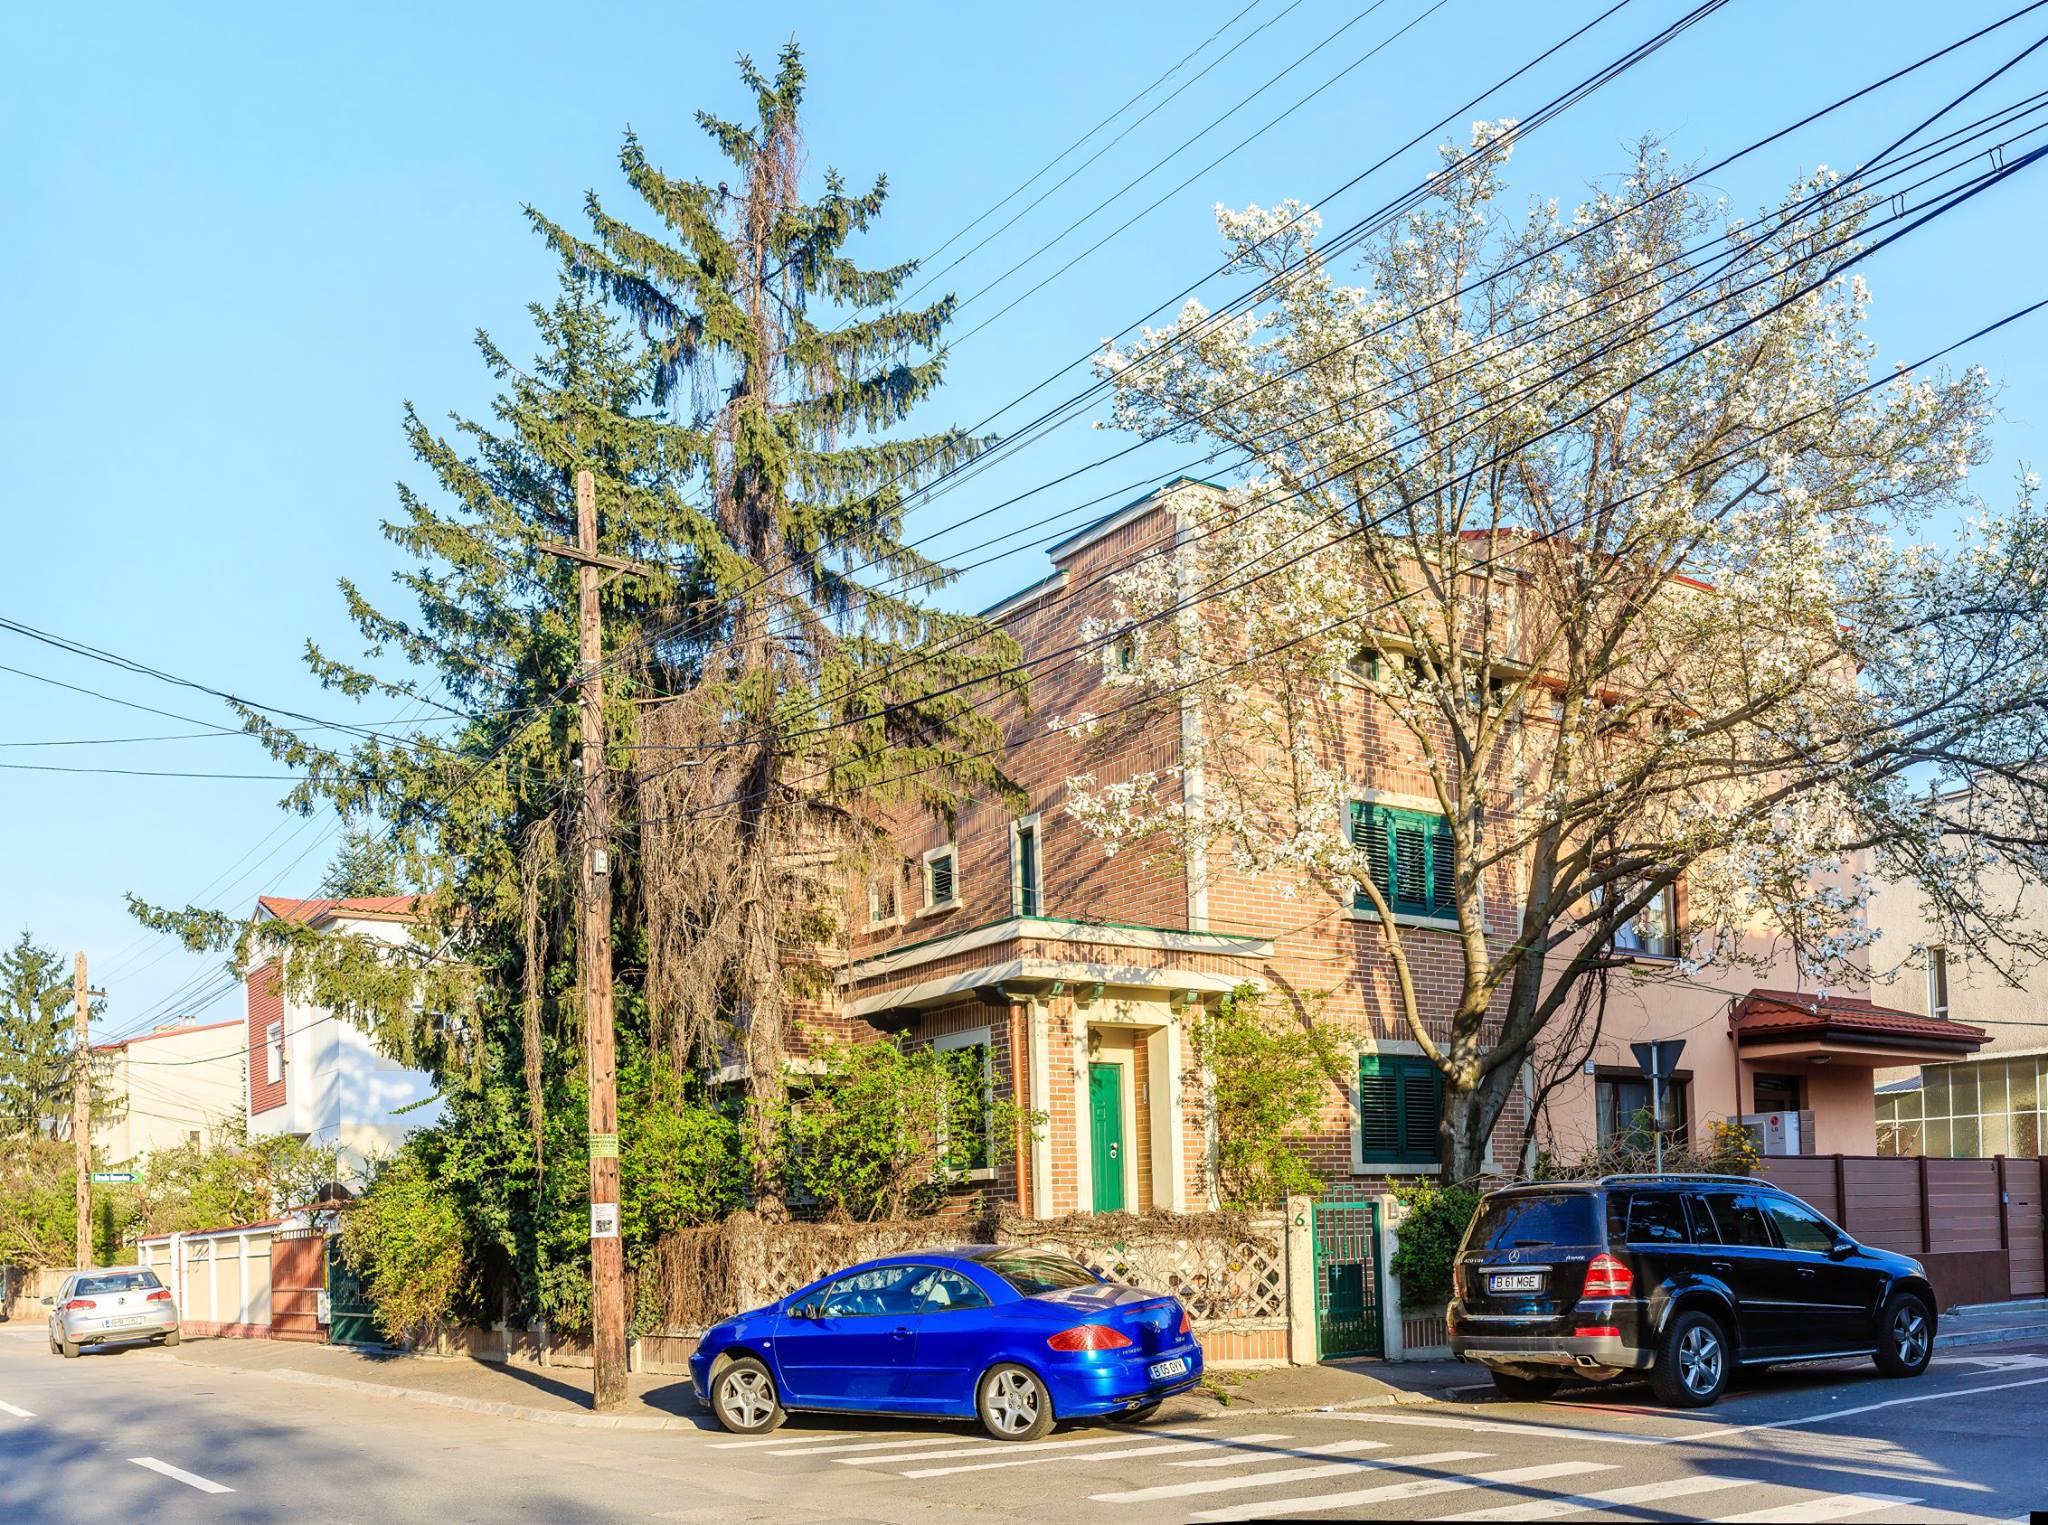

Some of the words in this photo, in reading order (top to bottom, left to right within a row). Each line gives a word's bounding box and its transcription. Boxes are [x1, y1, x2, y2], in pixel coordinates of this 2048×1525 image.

[1295, 1212, 1305, 1226] 6
[1496, 1276, 1502, 1287] B
[1505, 1276, 1514, 1287] 61
[1516, 1276, 1535, 1287] MGE
[1153, 1366, 1160, 1377] B
[1160, 1363, 1170, 1375] 05
